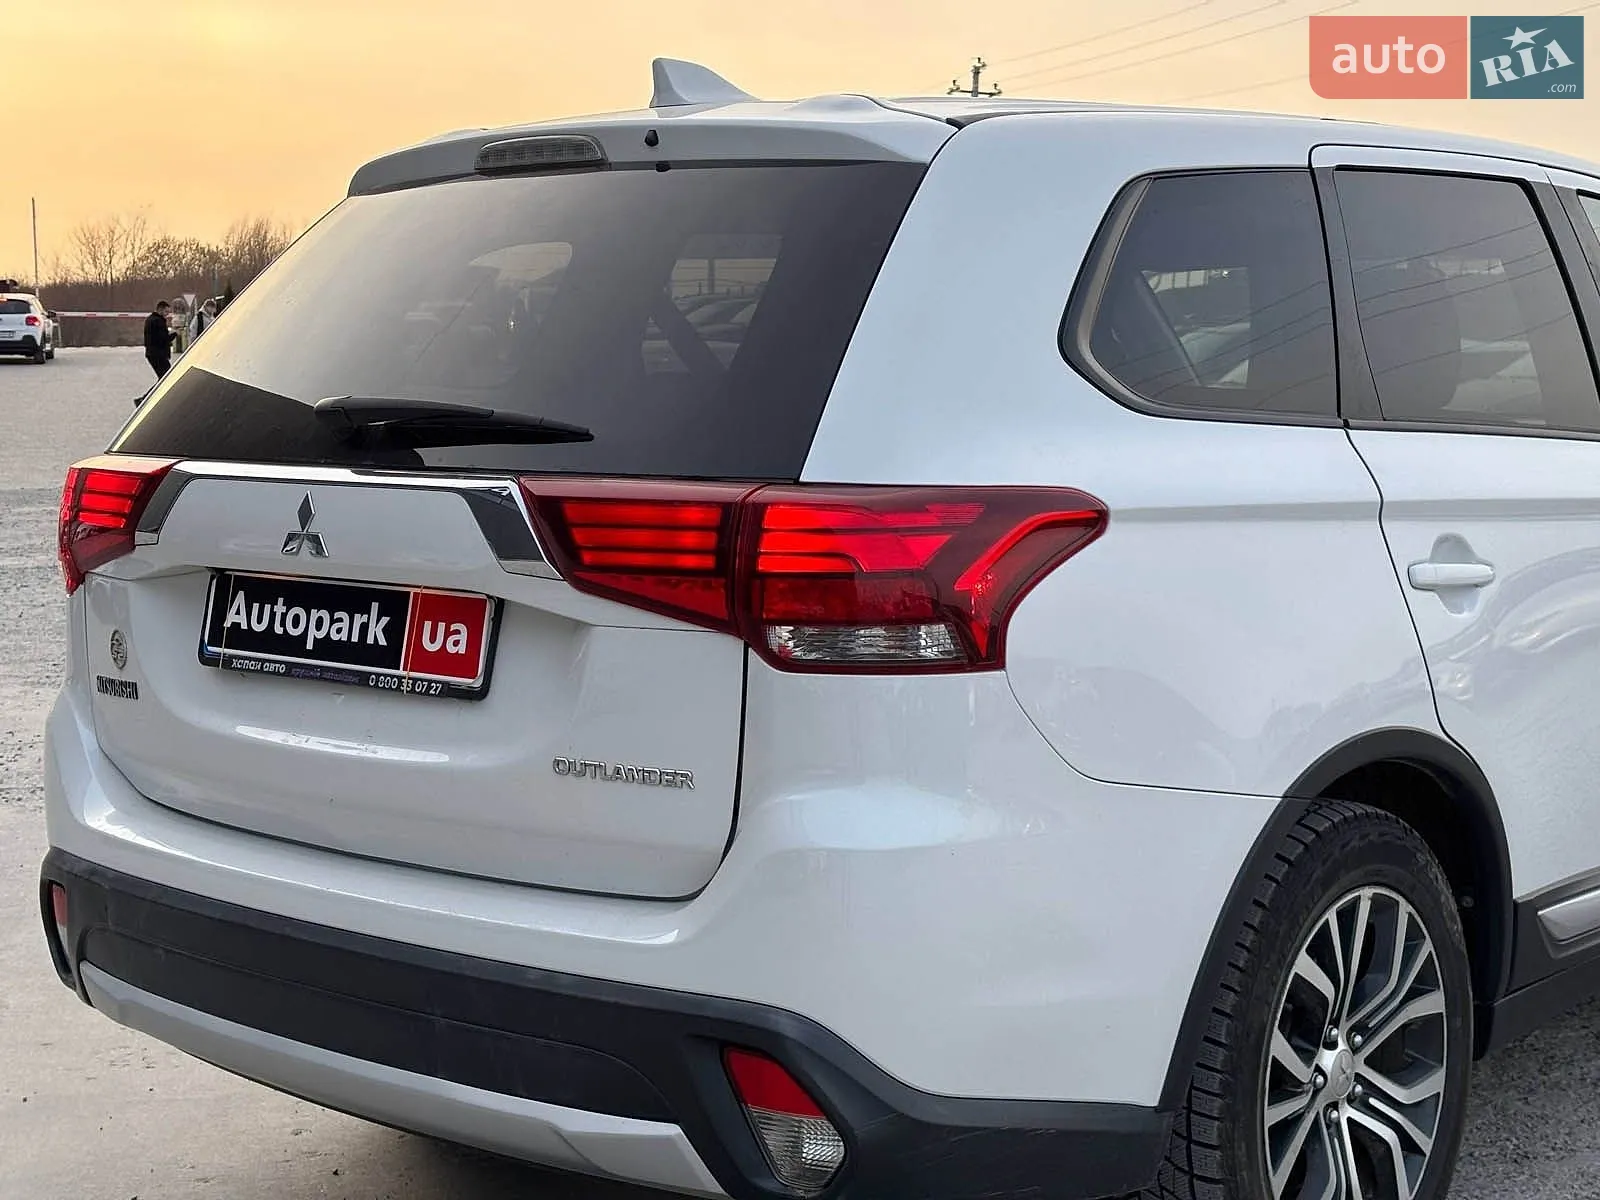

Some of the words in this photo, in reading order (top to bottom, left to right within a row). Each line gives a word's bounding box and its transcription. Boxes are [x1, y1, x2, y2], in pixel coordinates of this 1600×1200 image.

[224, 590, 391, 650] Autopark
[421, 620, 468, 655] ua
[378, 675, 399, 689] 800
[552, 756, 695, 790] OUTLANDER
